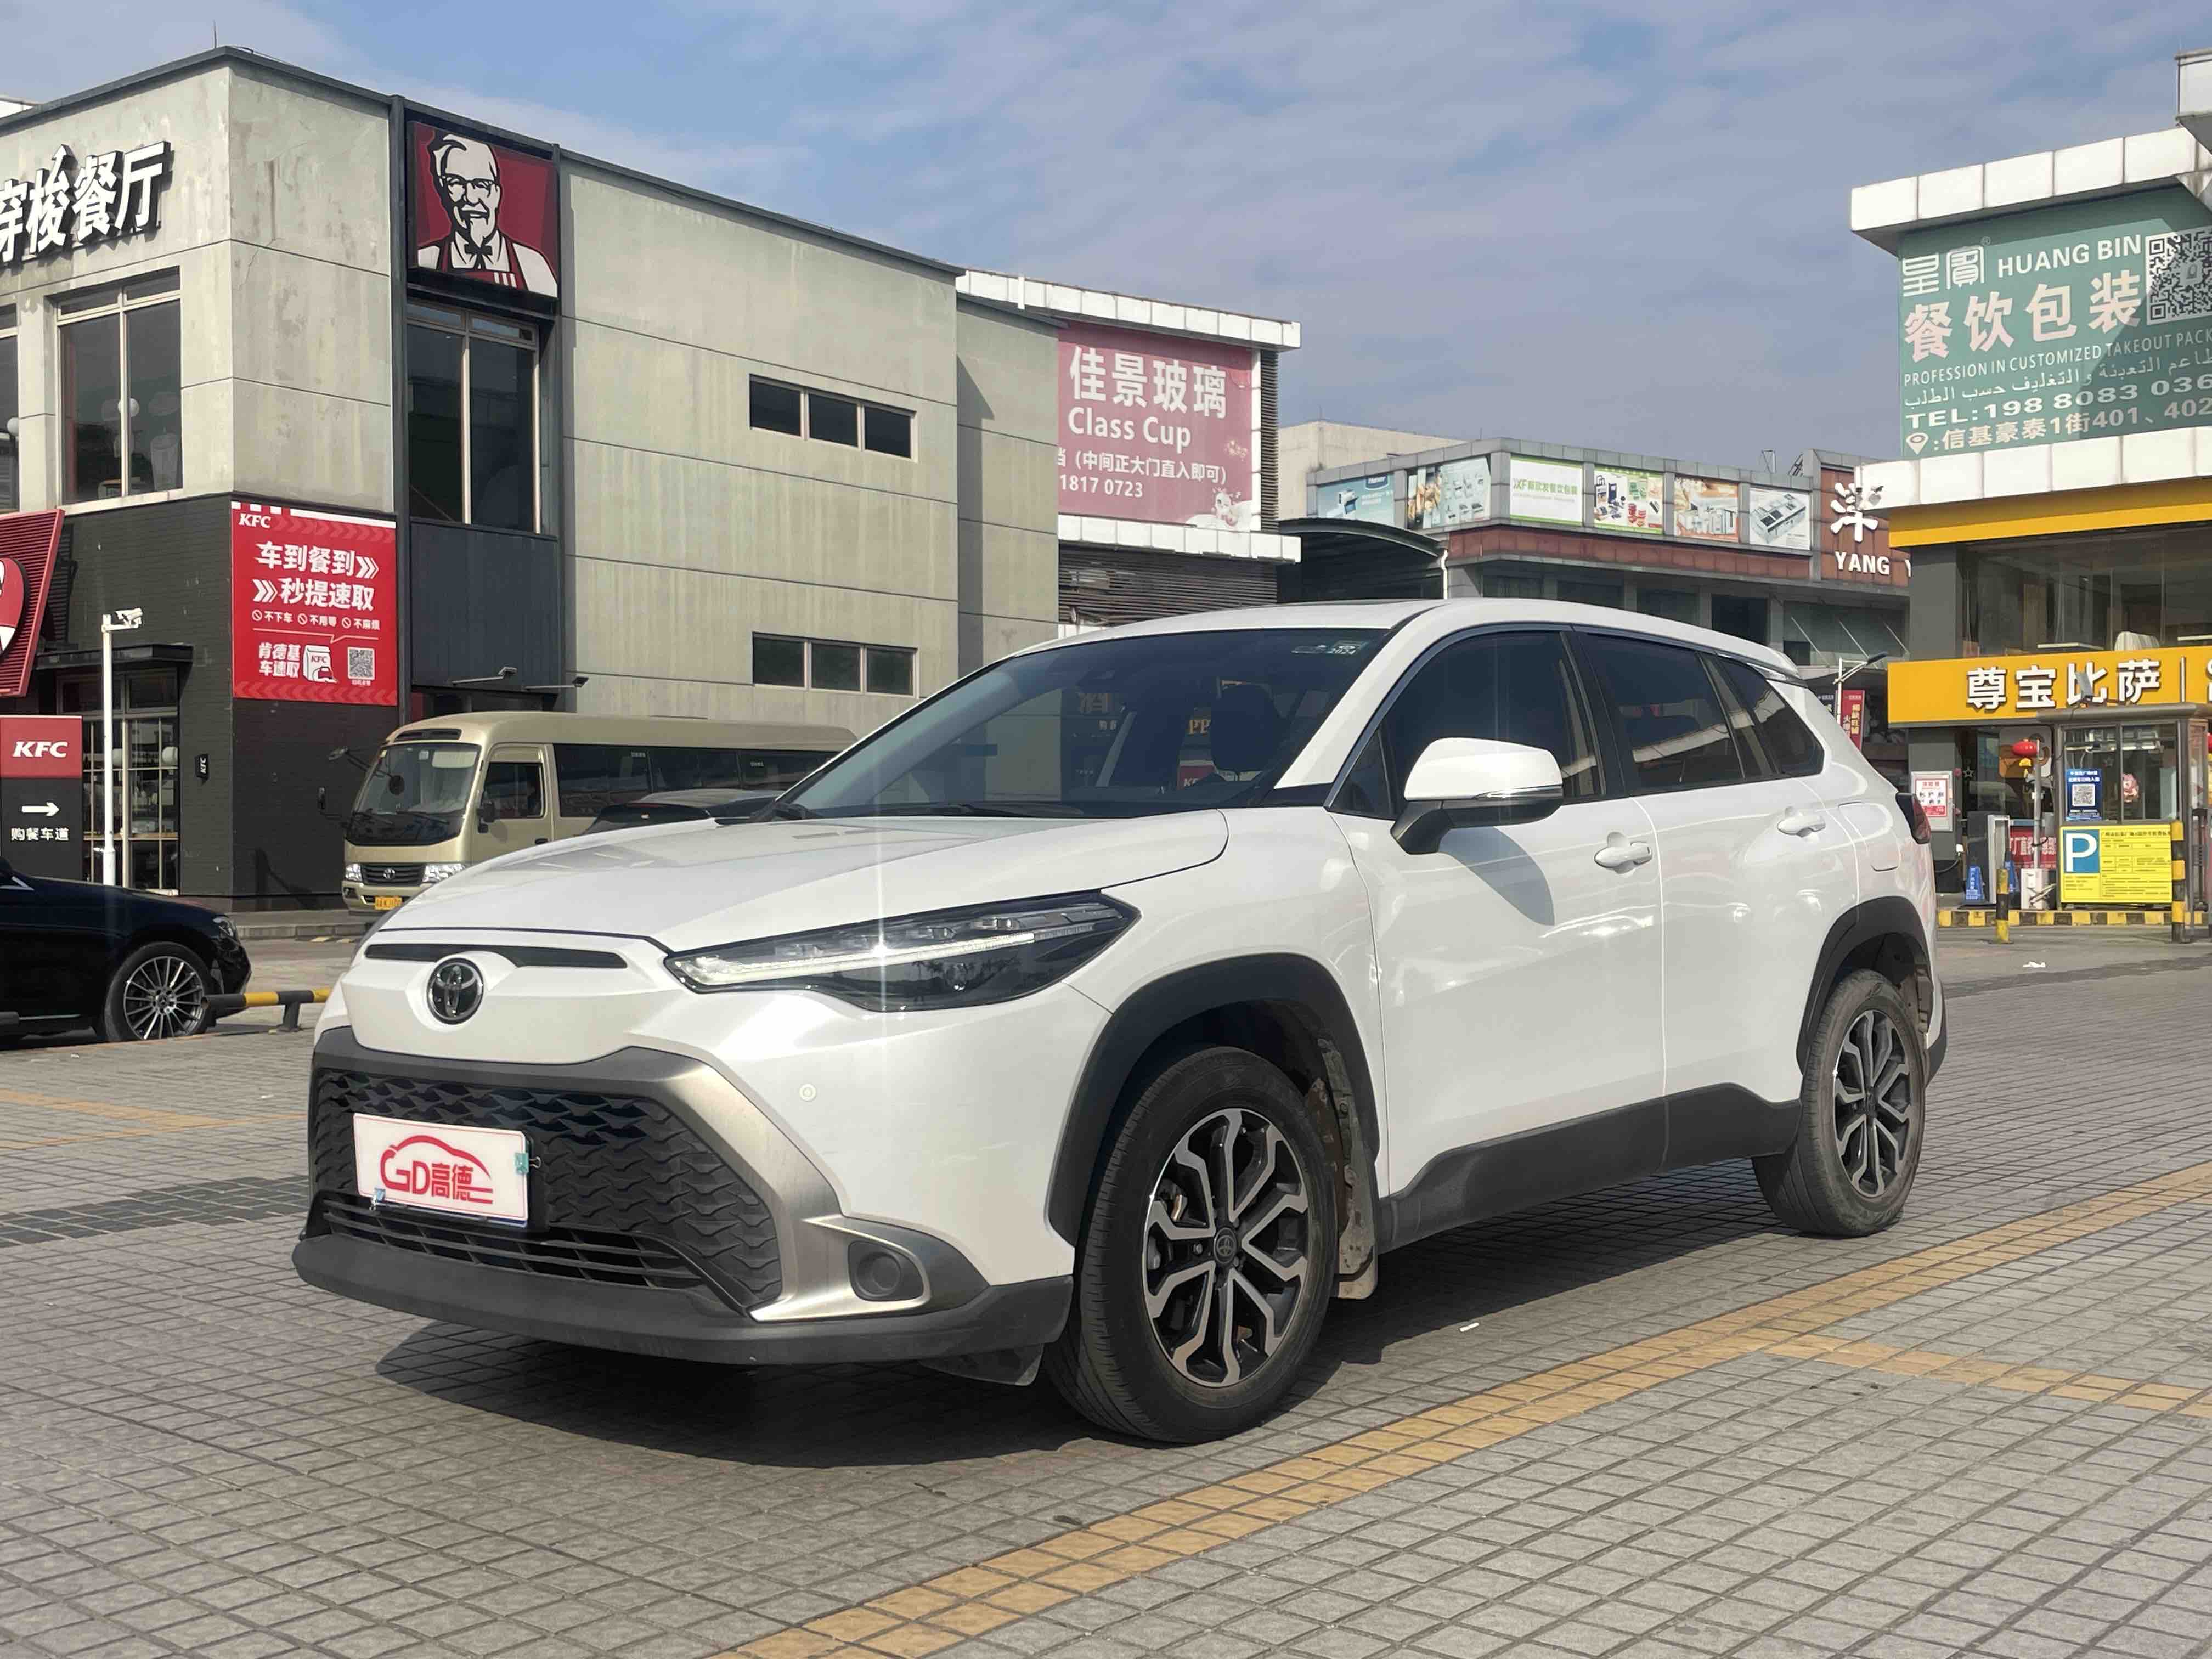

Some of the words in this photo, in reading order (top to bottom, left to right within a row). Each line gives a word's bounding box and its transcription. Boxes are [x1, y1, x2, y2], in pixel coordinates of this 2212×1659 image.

[1997, 244, 2090, 278] HUANG
[2097, 234, 2141, 261] BIN
[1904, 269, 2141, 363] 餐饮包装
[1904, 362, 1987, 386] PROFESSION
[1991, 359, 2005, 374] IN
[2010, 345, 2102, 371] CUSTOMIZED
[2106, 334, 2172, 357] TAKEOUT
[1070, 346, 1227, 419] 佳景玻璃
[2053, 385, 2138, 409] 8083
[1068, 407, 1135, 441] Class
[1143, 416, 1191, 454] Cup
[1060, 473, 1099, 493] 1817
[1104, 478, 1143, 498] 0723
[239, 513, 271, 528] KFC
[254, 541, 356, 577] 车到餐到
[1835, 551, 1890, 575] YANG
[278, 577, 375, 611] 秒提速取
[264, 611, 293, 623] 不下车
[258, 642, 301, 661] 肯德基
[311, 655, 328, 663] KFC
[259, 660, 300, 678] 车速取
[1966, 658, 2161, 710] 尊宝比萨
[12, 741, 69, 758] KFC
[10, 827, 69, 842] 购餐车道
[2065, 833, 2097, 872] P
